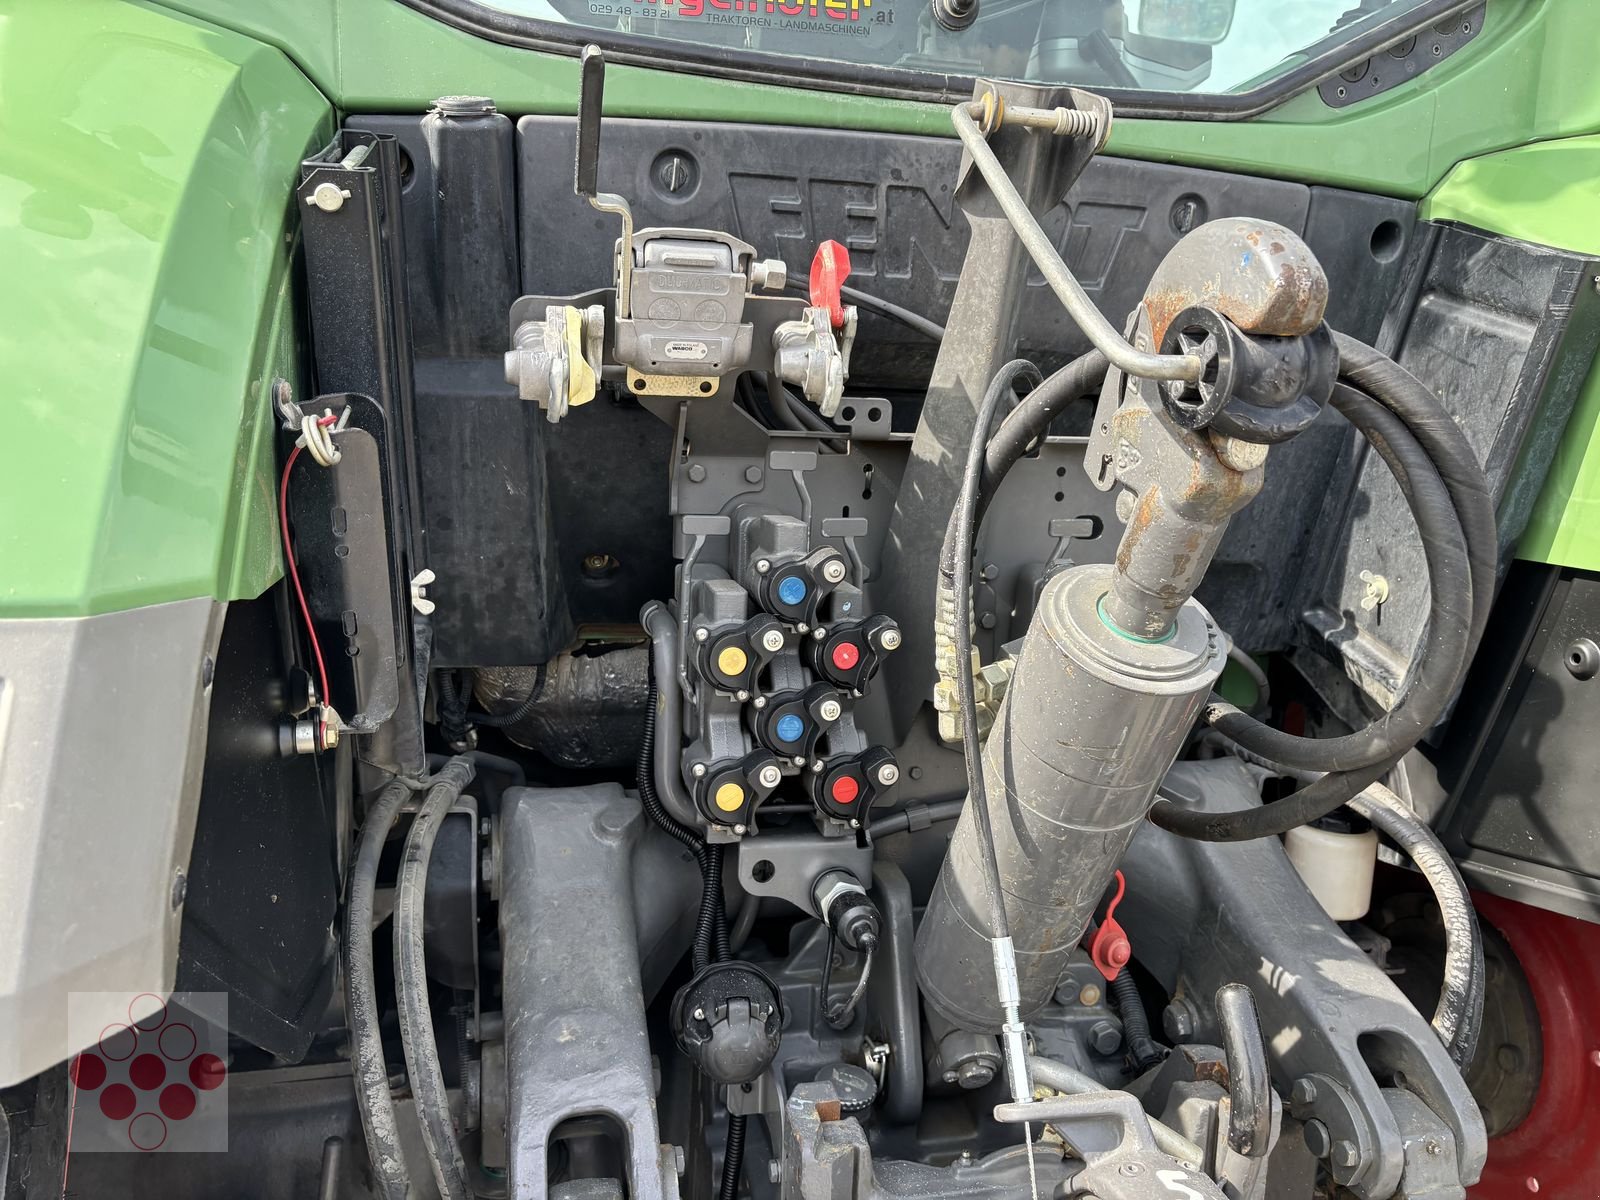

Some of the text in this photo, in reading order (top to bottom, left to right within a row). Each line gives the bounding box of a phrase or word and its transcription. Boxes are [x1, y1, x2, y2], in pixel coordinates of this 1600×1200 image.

[590, 3, 613, 14] 029
[616, 6, 632, 15] 48
[643, 8, 657, 17] 83
[660, 9, 670, 18] 21
[706, 13, 771, 27] TRAKTOREN
[780, 20, 871, 35] LANDMASCHINEN
